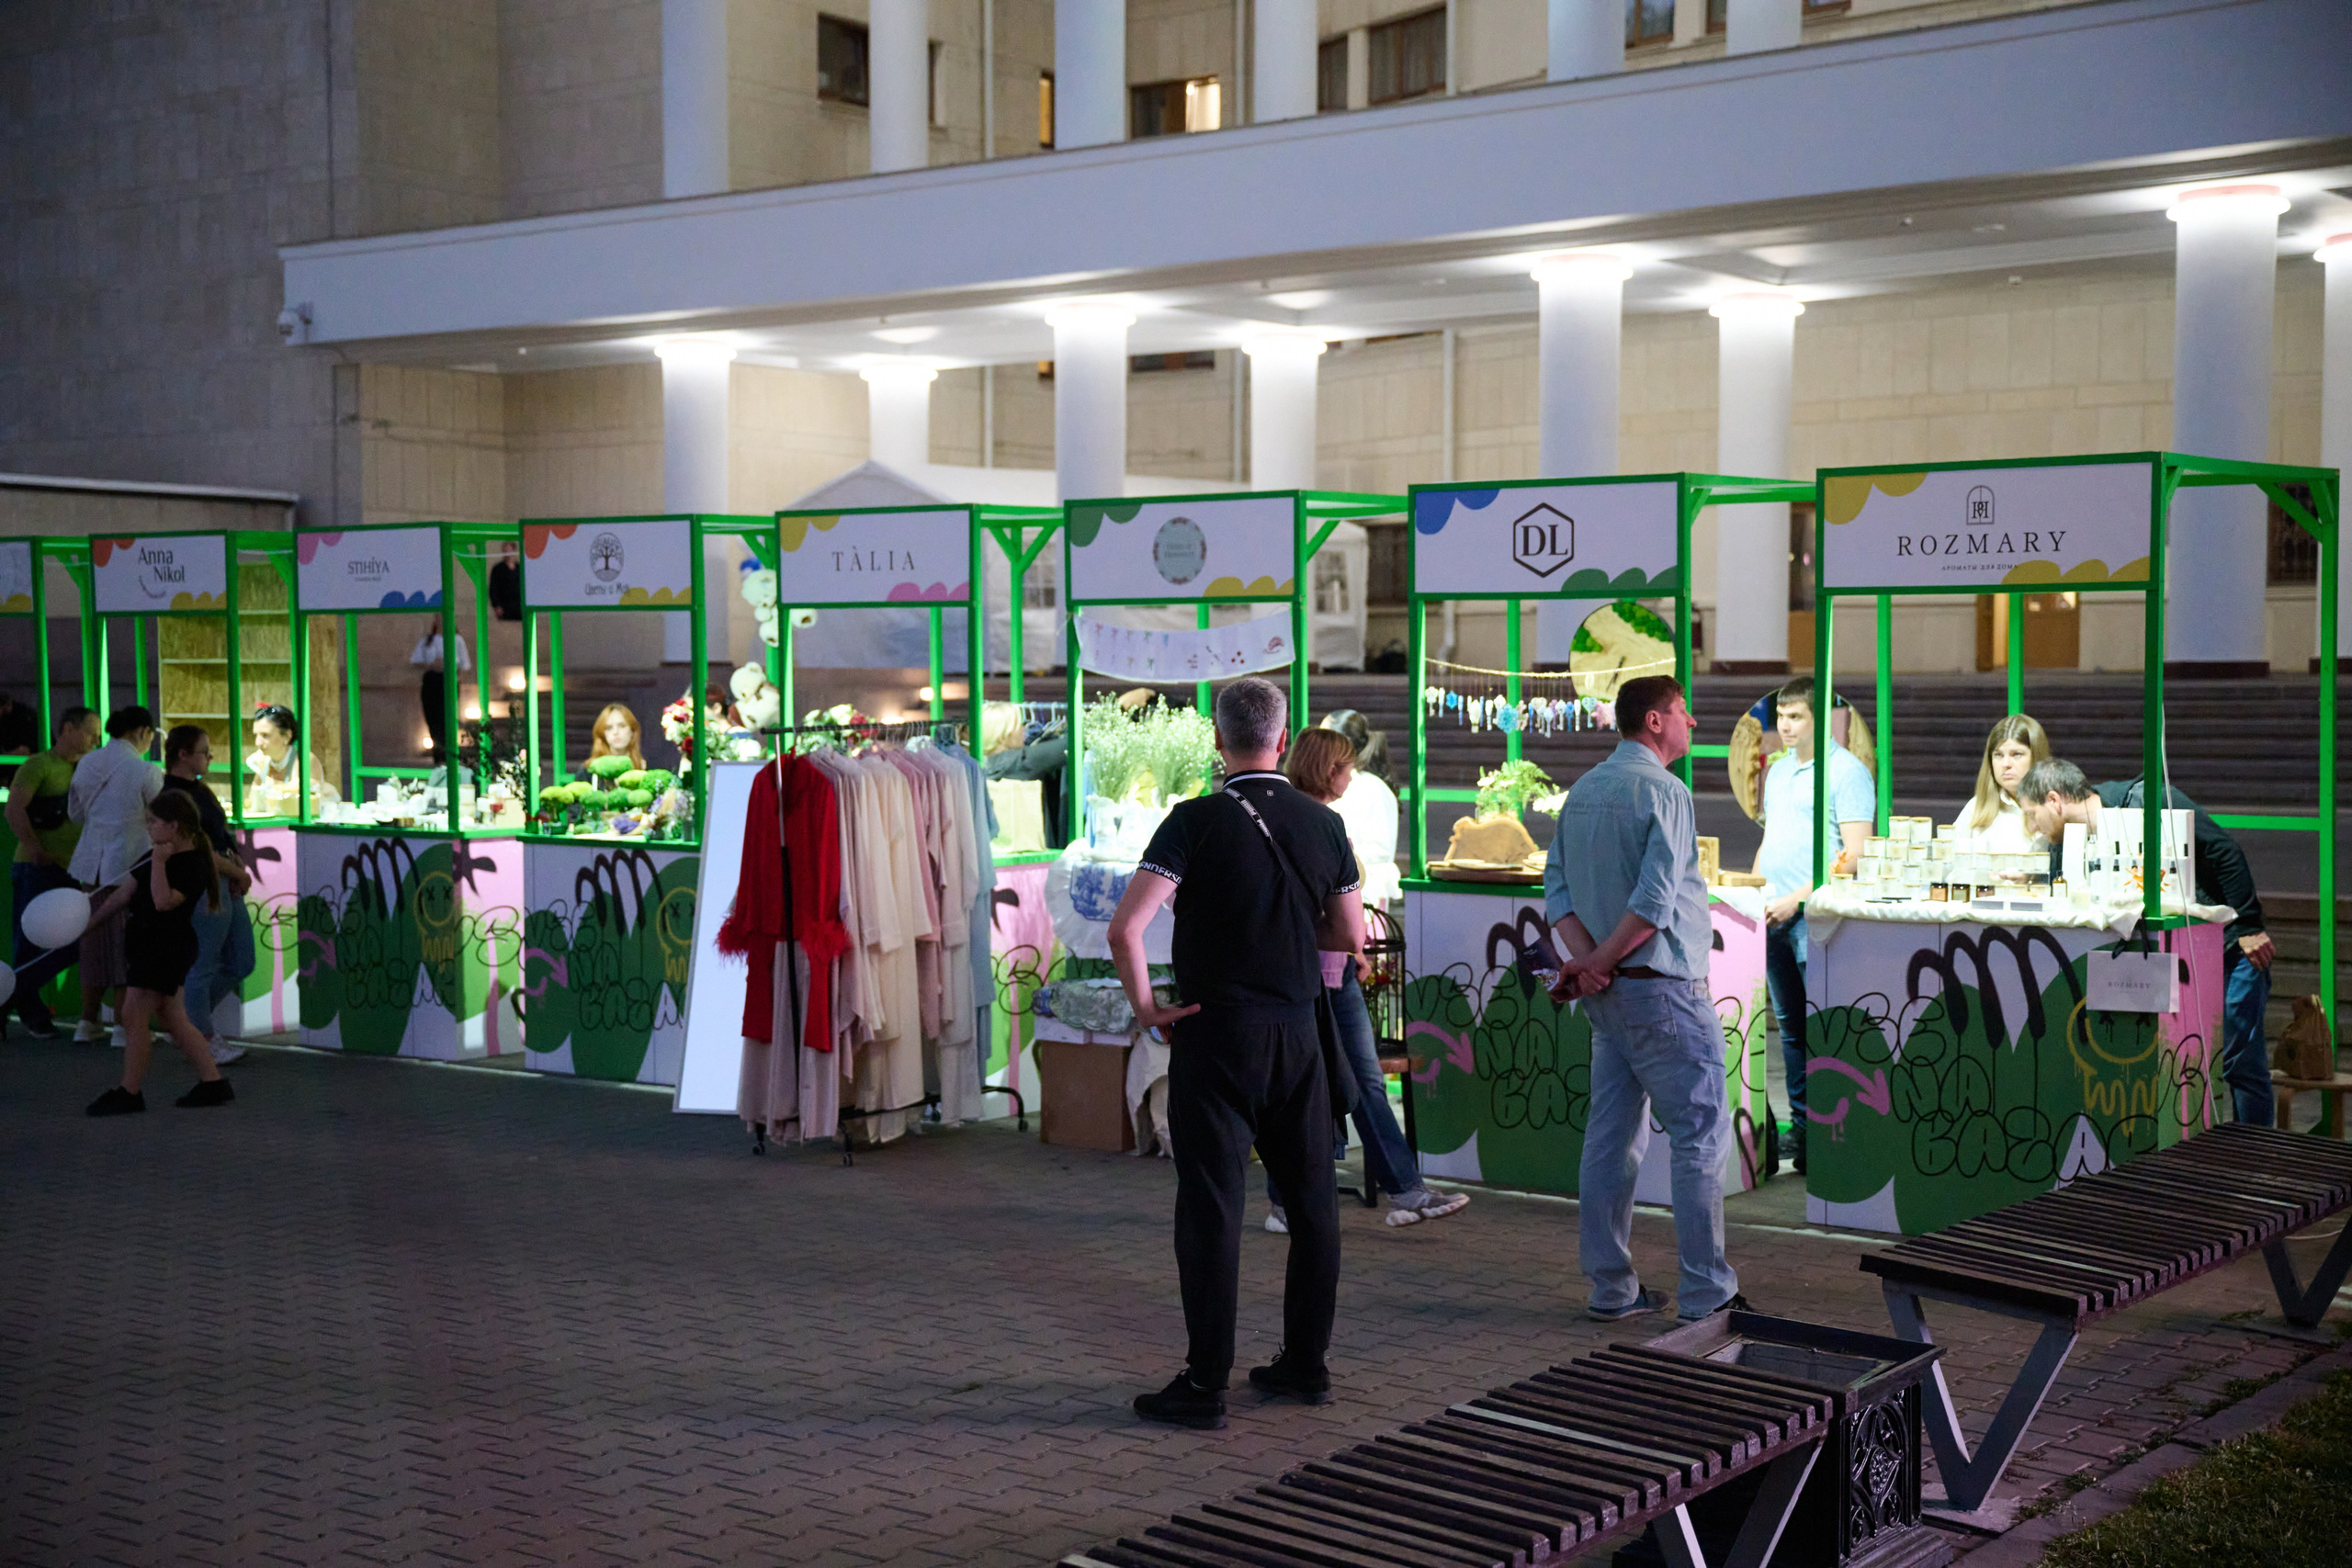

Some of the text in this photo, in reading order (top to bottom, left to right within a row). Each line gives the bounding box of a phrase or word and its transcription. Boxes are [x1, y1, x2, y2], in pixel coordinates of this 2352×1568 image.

[1521, 524, 1569, 558] DL
[1896, 531, 2067, 557] ROZMARY
[138, 546, 174, 565] Anna
[831, 547, 916, 572] TÀLIA
[153, 563, 186, 582] Nikol
[2108, 980, 2151, 989] ROZMARY
